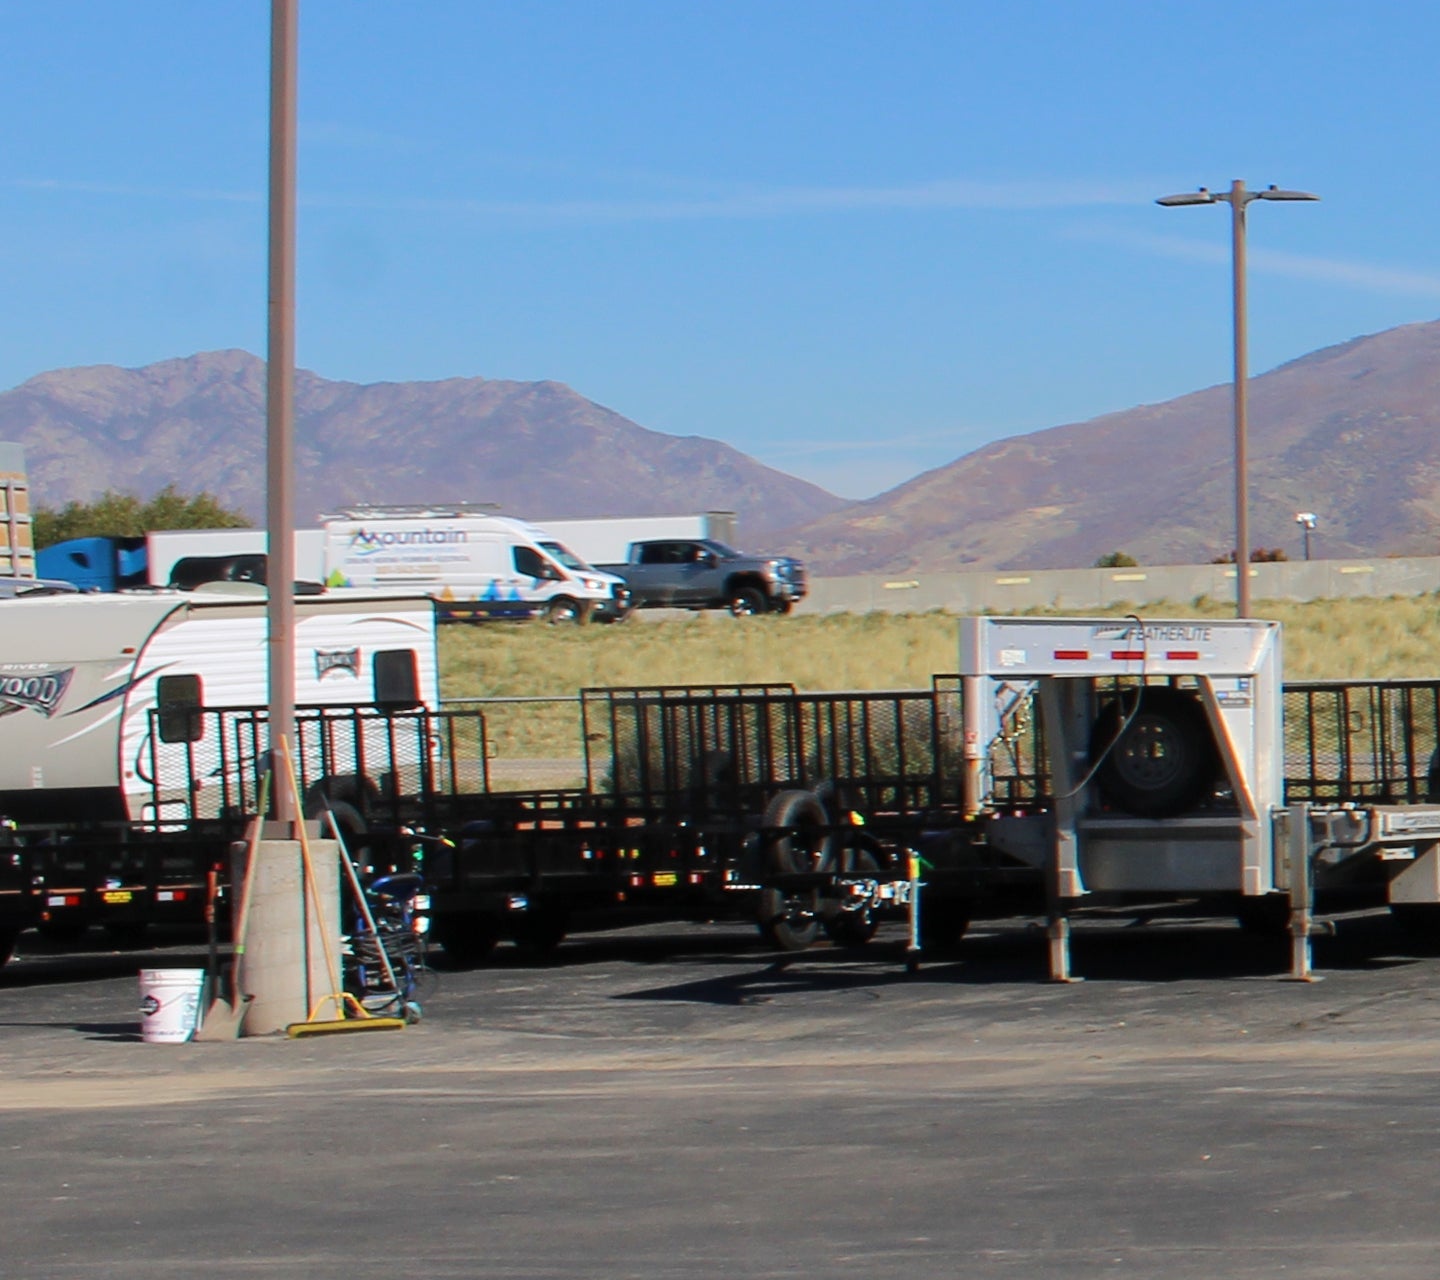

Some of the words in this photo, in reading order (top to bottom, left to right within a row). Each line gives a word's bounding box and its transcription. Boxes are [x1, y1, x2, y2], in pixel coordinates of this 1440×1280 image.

[350, 528, 467, 547] Mountain
[1128, 627, 1212, 640] FEATHERLITE
[1, 663, 49, 671] RIVER
[0, 677, 57, 702] OOD
